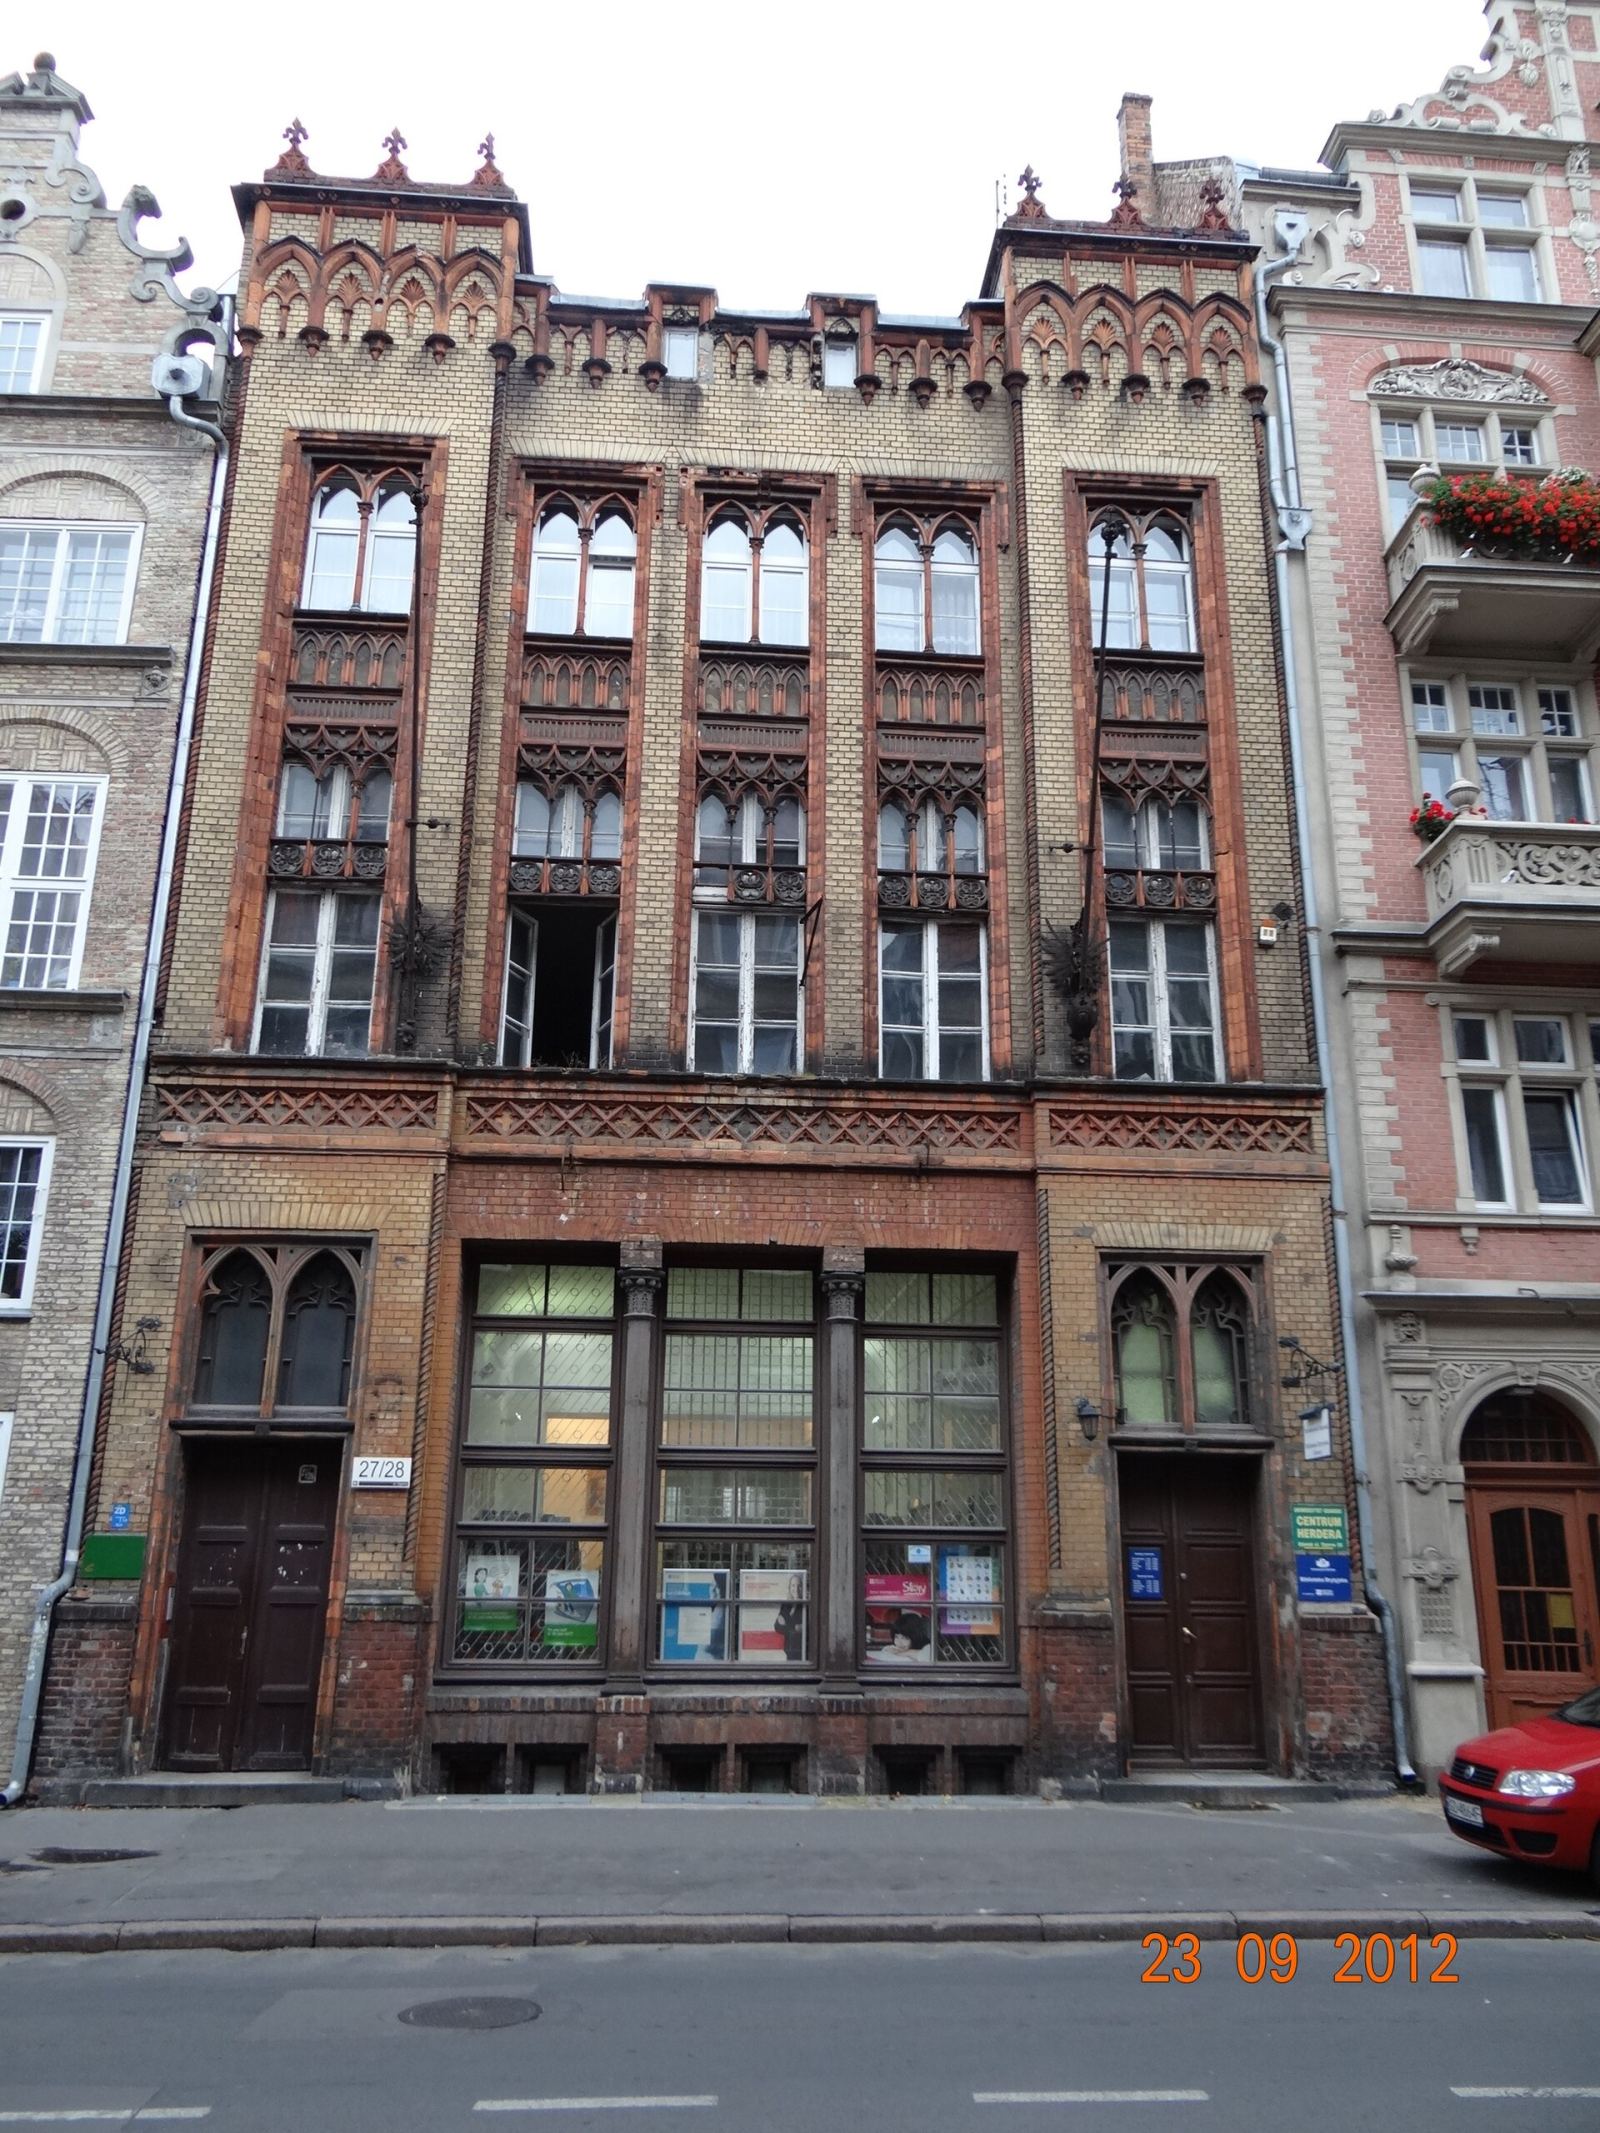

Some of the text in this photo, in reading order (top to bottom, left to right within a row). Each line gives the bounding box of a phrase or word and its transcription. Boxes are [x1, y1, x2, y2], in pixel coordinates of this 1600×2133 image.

[358, 1460, 405, 1478] 27/28
[1296, 1515, 1343, 1528] CENTRUM
[1296, 1527, 1343, 1540] HERDERA
